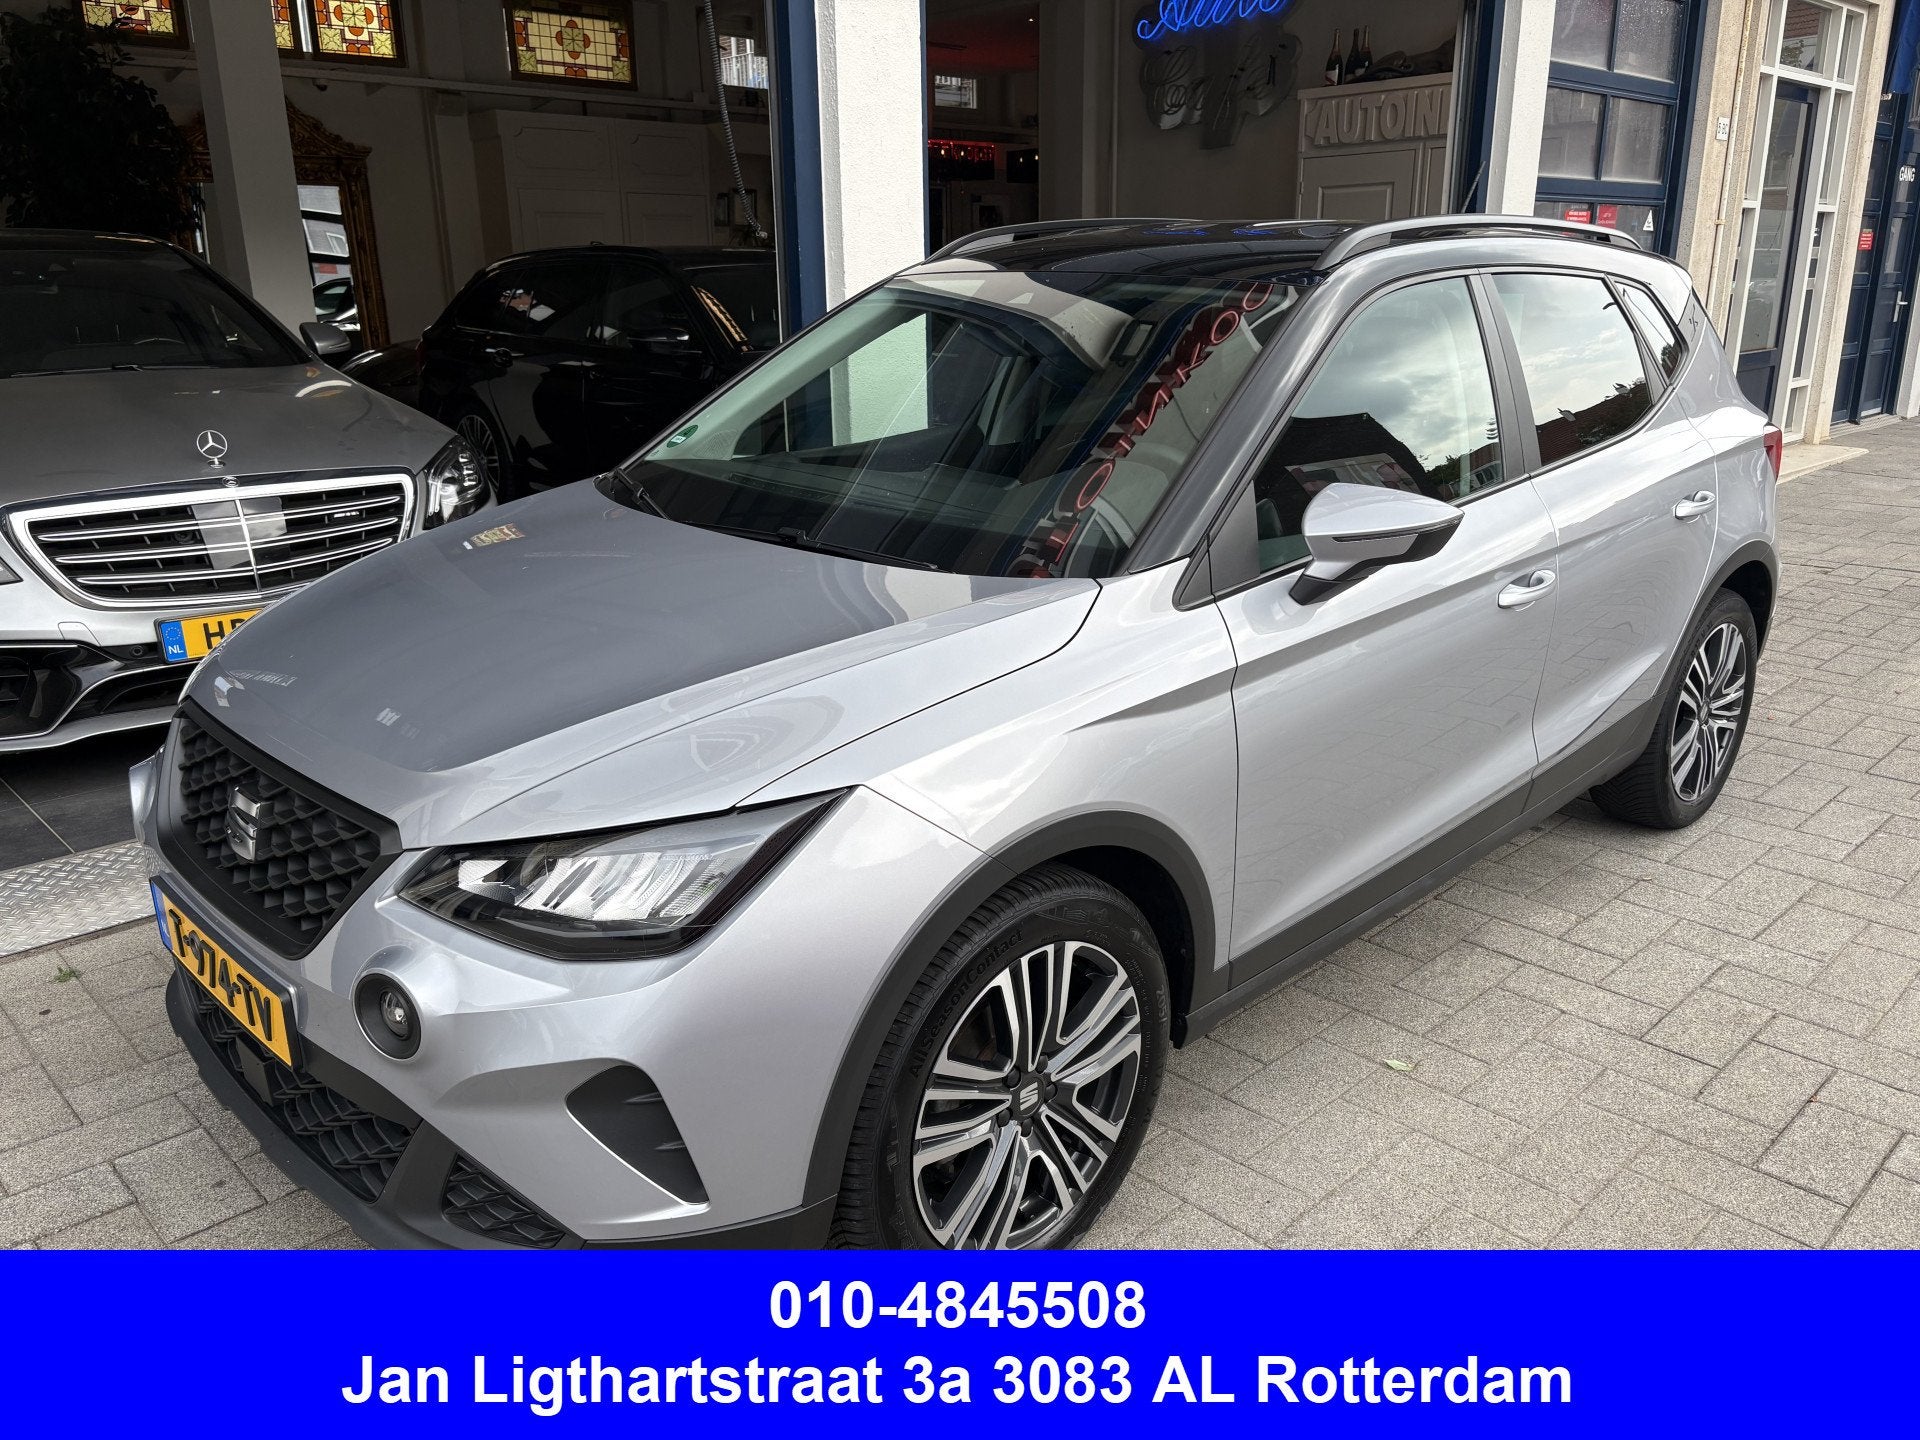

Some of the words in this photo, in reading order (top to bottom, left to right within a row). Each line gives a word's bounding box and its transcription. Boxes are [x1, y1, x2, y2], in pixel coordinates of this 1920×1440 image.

[1899, 165, 1916, 182] GANG
[168, 645, 184, 654] NL
[168, 908, 273, 1041] T-974-TV
